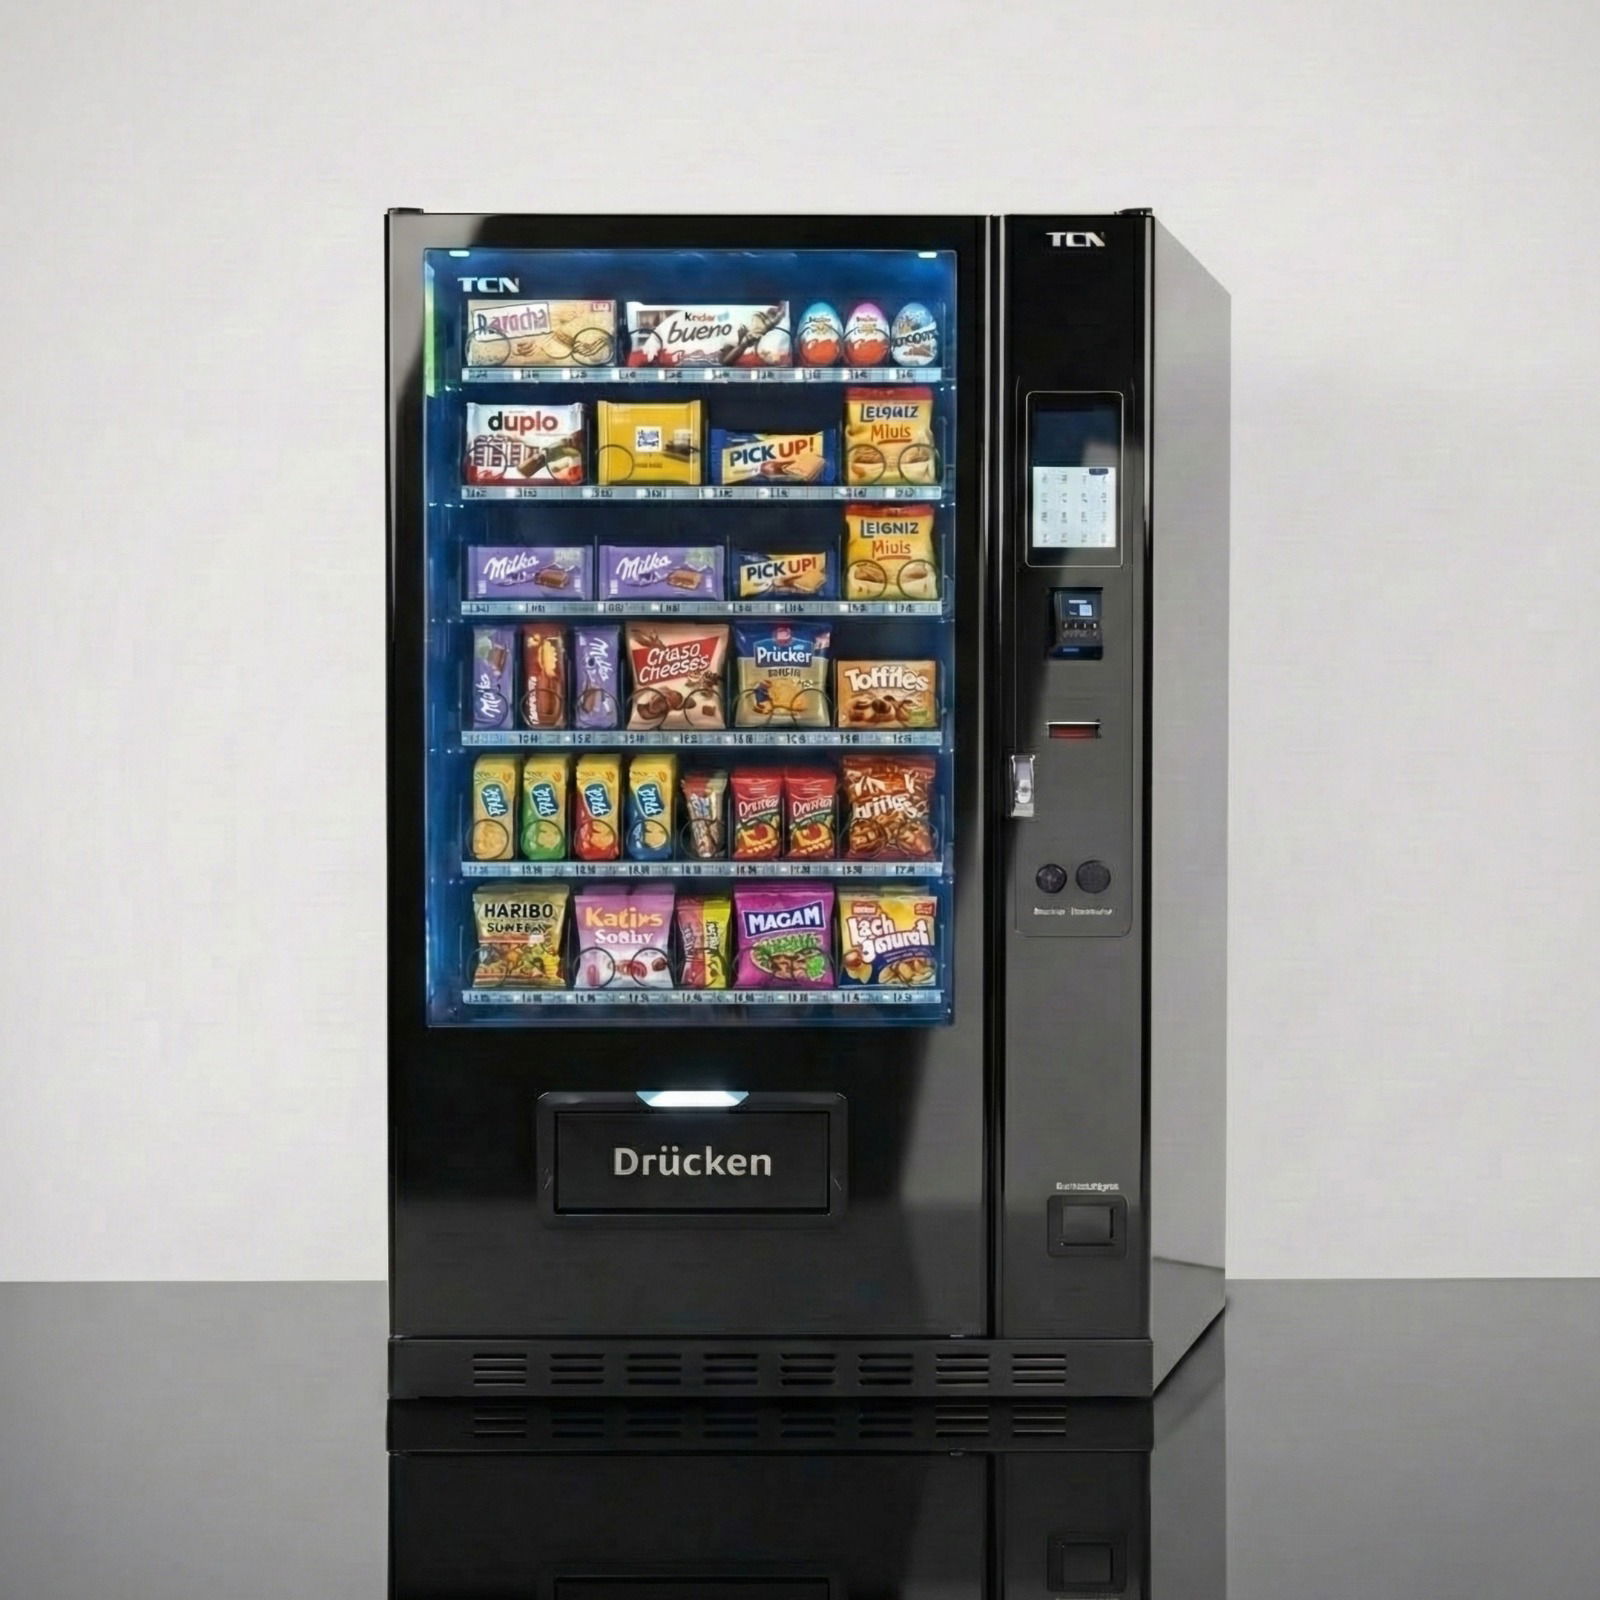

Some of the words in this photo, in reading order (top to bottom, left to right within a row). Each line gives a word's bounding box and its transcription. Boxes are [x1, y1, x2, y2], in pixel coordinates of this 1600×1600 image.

[1045, 231, 1106, 247] TCN
[457, 277, 520, 293] TCN
[667, 321, 732, 344] bueno
[488, 411, 558, 435] duplo
[729, 443, 776, 466] PICK
[779, 437, 814, 457] UP!
[860, 519, 919, 538] LEIGNIZ
[483, 552, 540, 580] Milka
[616, 551, 672, 580] Milka
[747, 561, 786, 581] PICK
[484, 903, 553, 918] HARIBO
[613, 1145, 772, 1177] Drücken
